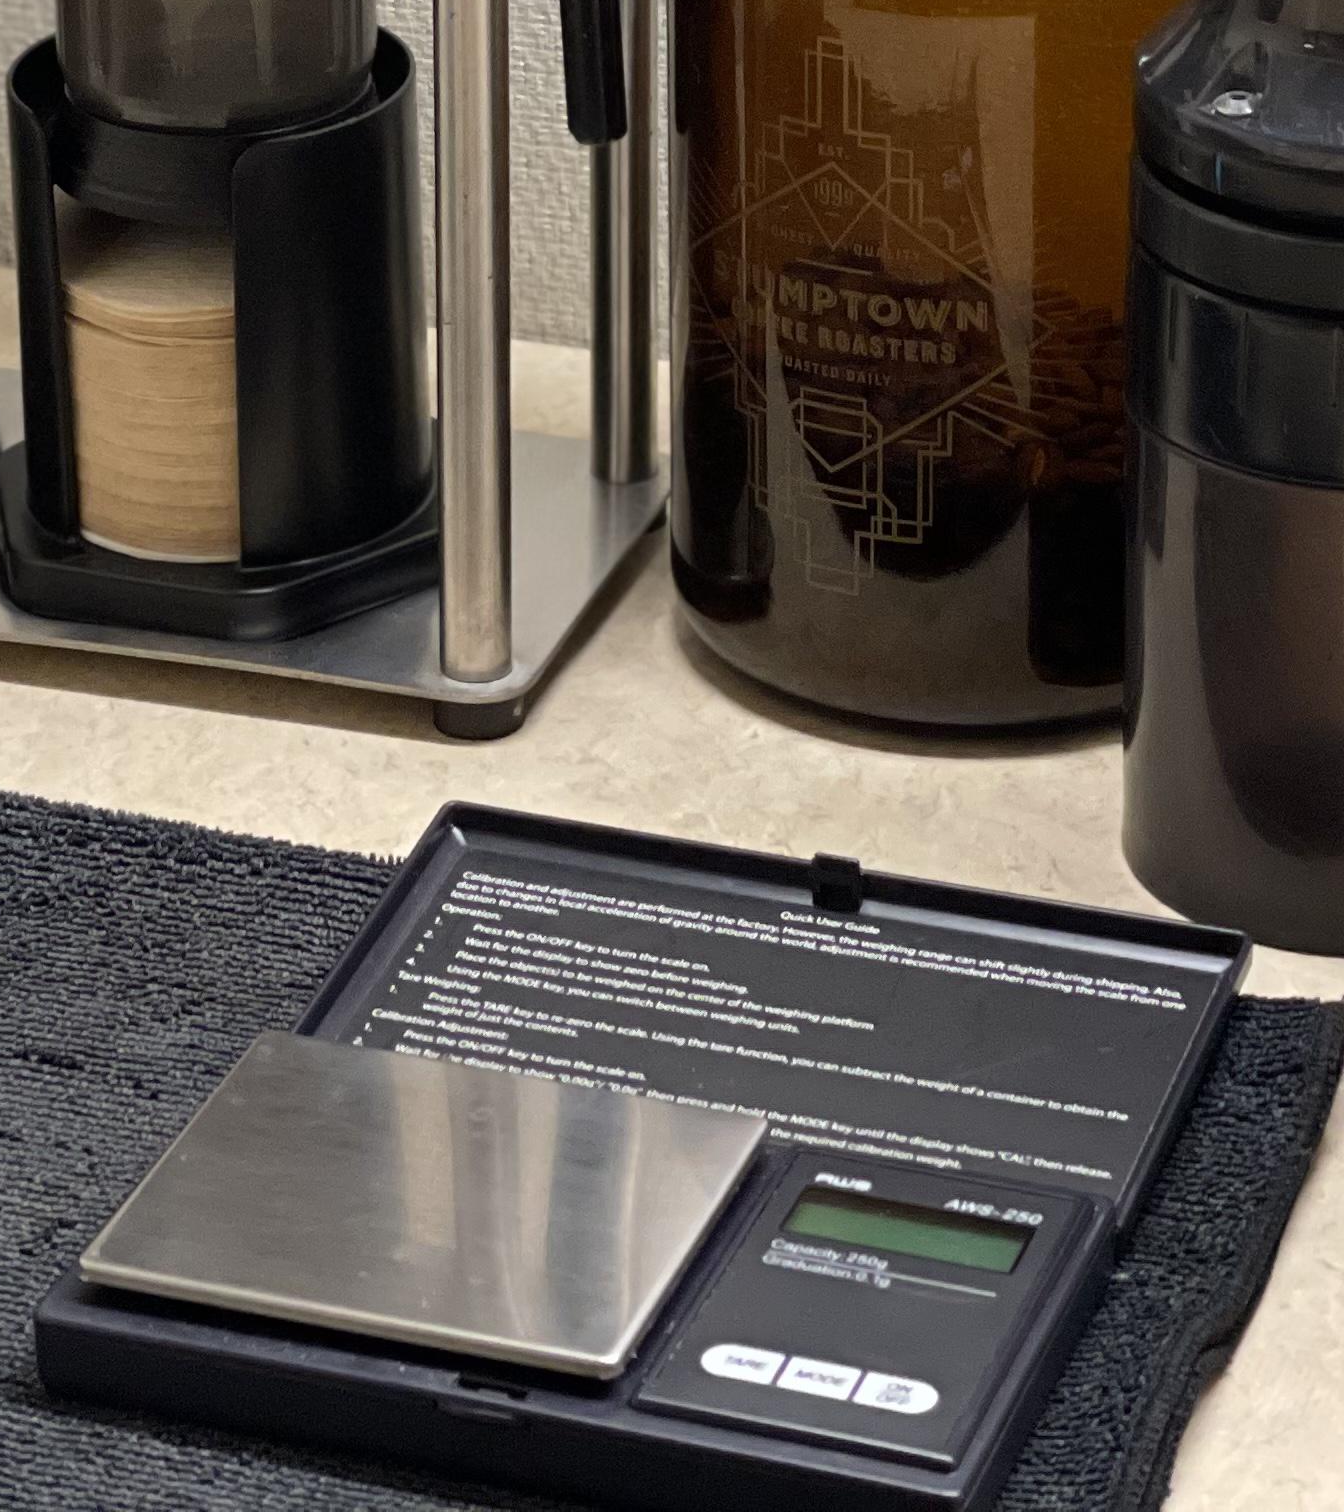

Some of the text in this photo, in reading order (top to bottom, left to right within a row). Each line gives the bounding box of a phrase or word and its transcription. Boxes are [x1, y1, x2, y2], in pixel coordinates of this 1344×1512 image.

[463, 871, 525, 888] Calibration
[525, 883, 550, 893] and
[550, 888, 616, 905] adjustment
[617, 899, 637, 908] are
[637, 903, 701, 919] performed
[701, 914, 714, 922] at
[715, 915, 736, 925] the
[839, 936, 859, 946] the
[861, 941, 916, 956] weighing
[918, 950, 953, 961] range
[954, 956, 976, 965] can
[979, 959, 1006, 970] shift
[1007, 964, 1051, 978] slightly
[1052, 971, 1093, 985] during
[780, 911, 880, 934] Quick User Guide
[465, 937, 491, 949] Wait
[492, 942, 509, 952] for
[511, 946, 531, 956] the
[532, 950, 574, 964] display
[575, 957, 589, 966] to
[590, 960, 622, 972] show
[623, 966, 650, 976] zero
[650, 969, 690, 983] before
[473, 923, 503, 936] Press
[505, 929, 525, 940] the
[526, 933, 573, 947] ON/OFF
[574, 941, 596, 953] key
[597, 946, 610, 954] to
[612, 948, 637, 959] turn
[639, 953, 659, 963] the
[660, 958, 690, 968] scale
[398, 970, 422, 982] Tare
[447, 964, 480, 979] Using
[482, 971, 502, 981] the
[503, 974, 542, 988] MODE
[566, 987, 591, 997] you
[591, 991, 614, 1001] can
[616, 995, 654, 1008] switch
[655, 1001, 708, 1017] between
[710, 1012, 766, 1029] weighing
[455, 950, 487, 963] Place
[488, 957, 508, 967] the
[562, 970, 575, 979] to
[576, 972, 593, 982] be
[594, 977, 646, 991] weighed
[646, 986, 664, 994] on
[665, 988, 686, 998] the
[687, 993, 726, 1005] center
[727, 999, 742, 1007] of
[742, 1001, 763, 1011] the
[765, 1006, 820, 1023] weighing
[821, 1016, 874, 1030] platform
[372, 1008, 436, 1027] Calibration
[428, 992, 459, 1005] Press
[461, 998, 481, 1008] the
[483, 1001, 512, 1014] TARE
[513, 1006, 535, 1019] key
[536, 1011, 549, 1021] to
[594, 1022, 615, 1033] the
[651, 1031, 686, 1046] Using
[687, 1038, 708, 1049] the
[710, 1042, 734, 1053] tare
[790, 1057, 815, 1068] you
[816, 1062, 839, 1071] can
[841, 1066, 891, 1080] subtract
[893, 1073, 915, 1084] the
[917, 1079, 960, 1092] weight
[961, 1086, 977, 1095] of
[986, 1091, 1046, 1106] container
[1048, 1100, 1062, 1110] to
[1063, 1104, 1105, 1117] obtain
[1107, 1110, 1129, 1121] the
[943, 1198, 1044, 1226] AWS-250
[794, 1369, 849, 1387] MODE
